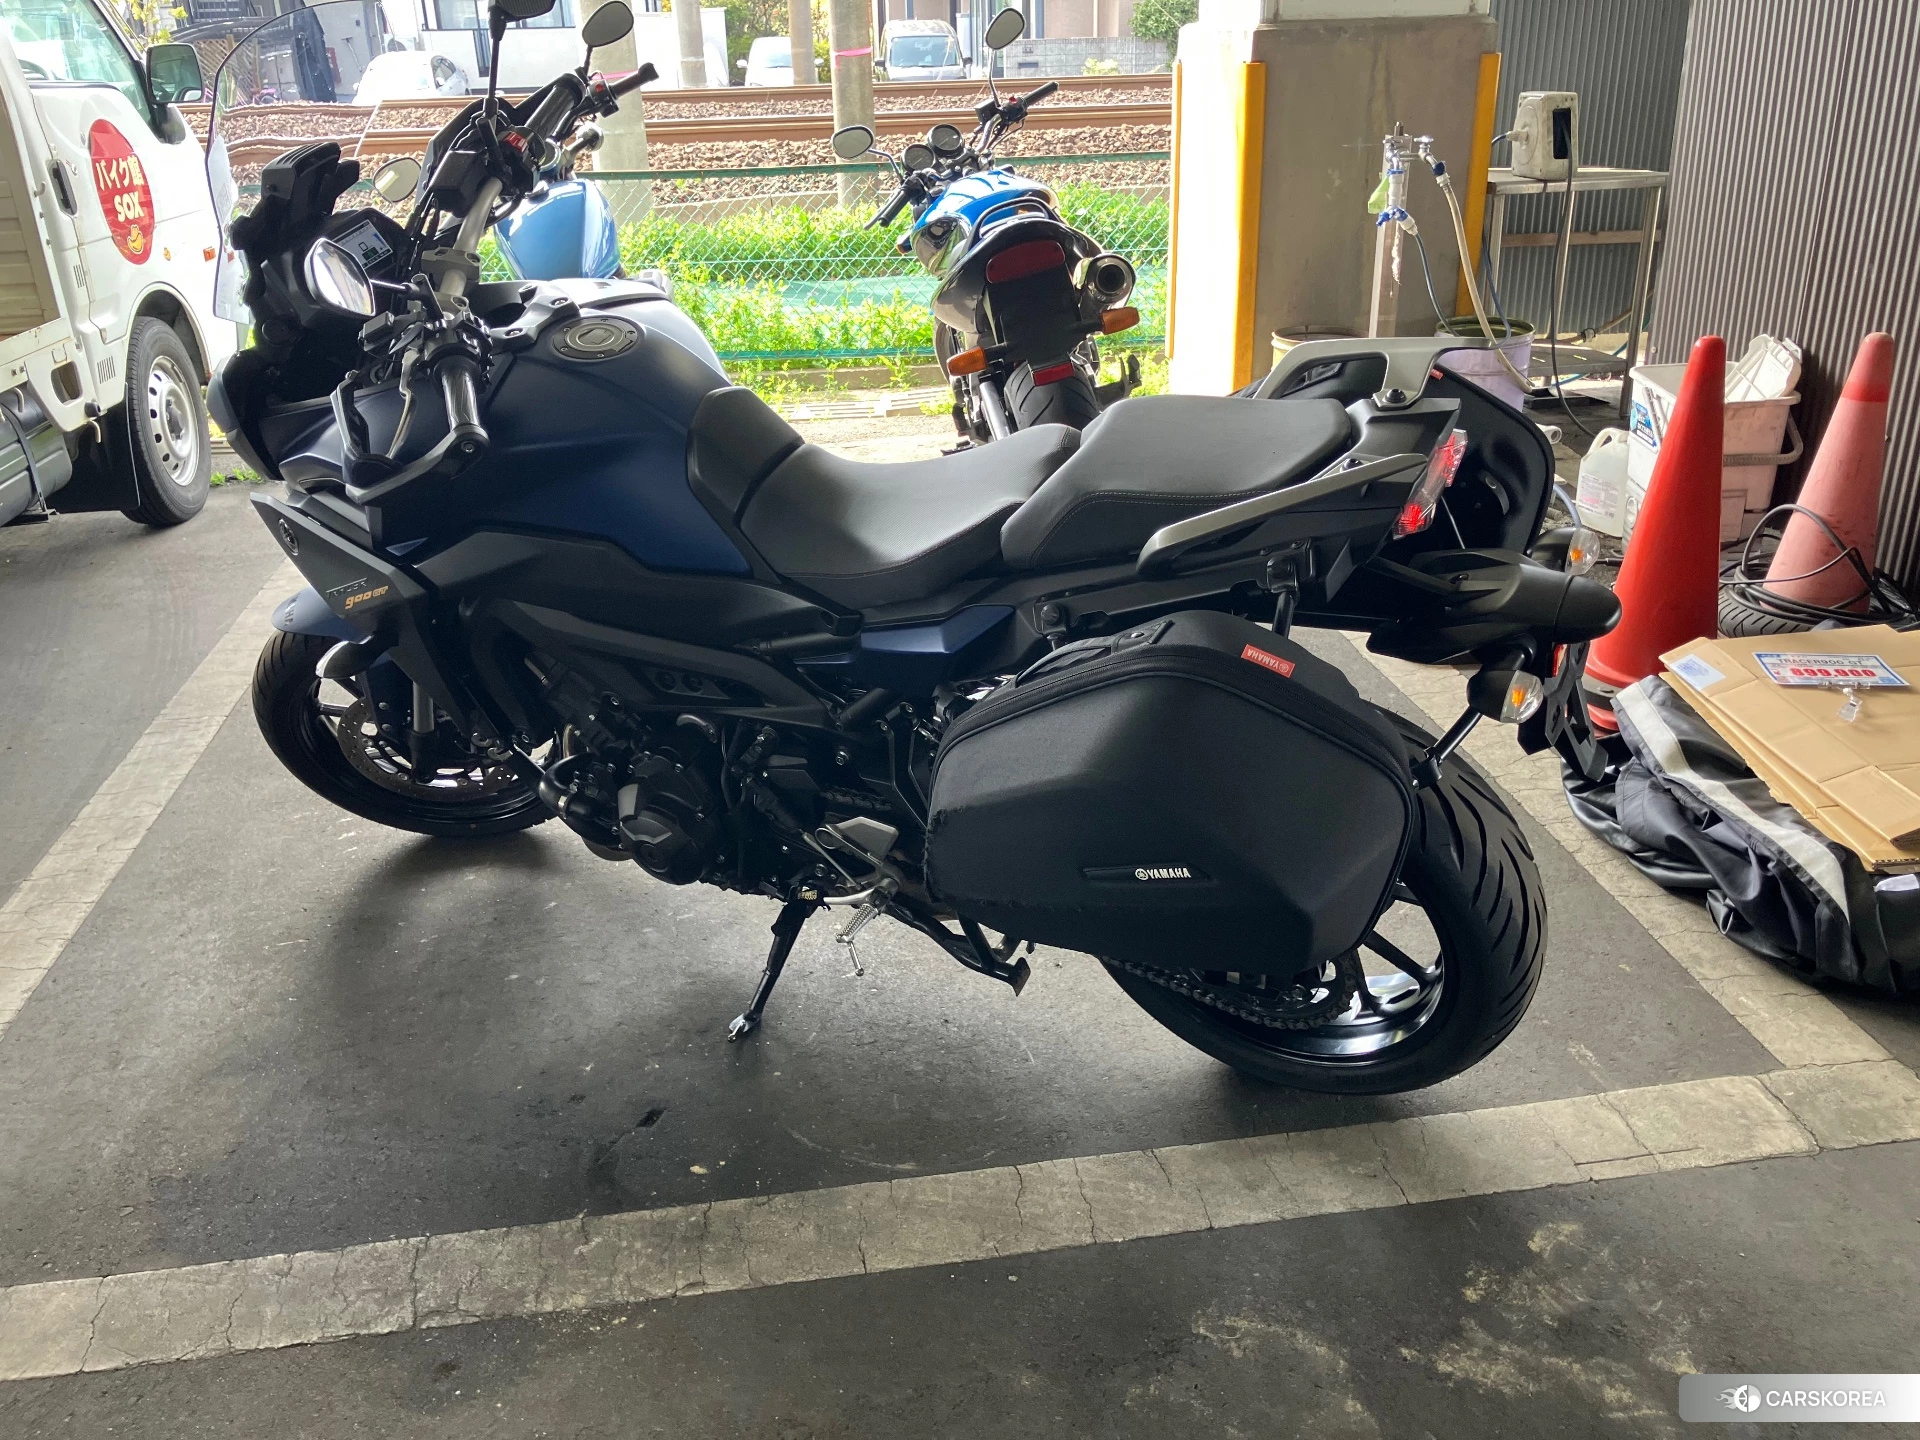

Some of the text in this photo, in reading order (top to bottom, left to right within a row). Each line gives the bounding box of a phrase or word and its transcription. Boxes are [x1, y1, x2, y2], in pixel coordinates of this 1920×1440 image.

[114, 191, 145, 223] SOX
[1247, 648, 1280, 670] YAMAHA
[1146, 867, 1192, 880] YAMAHA
